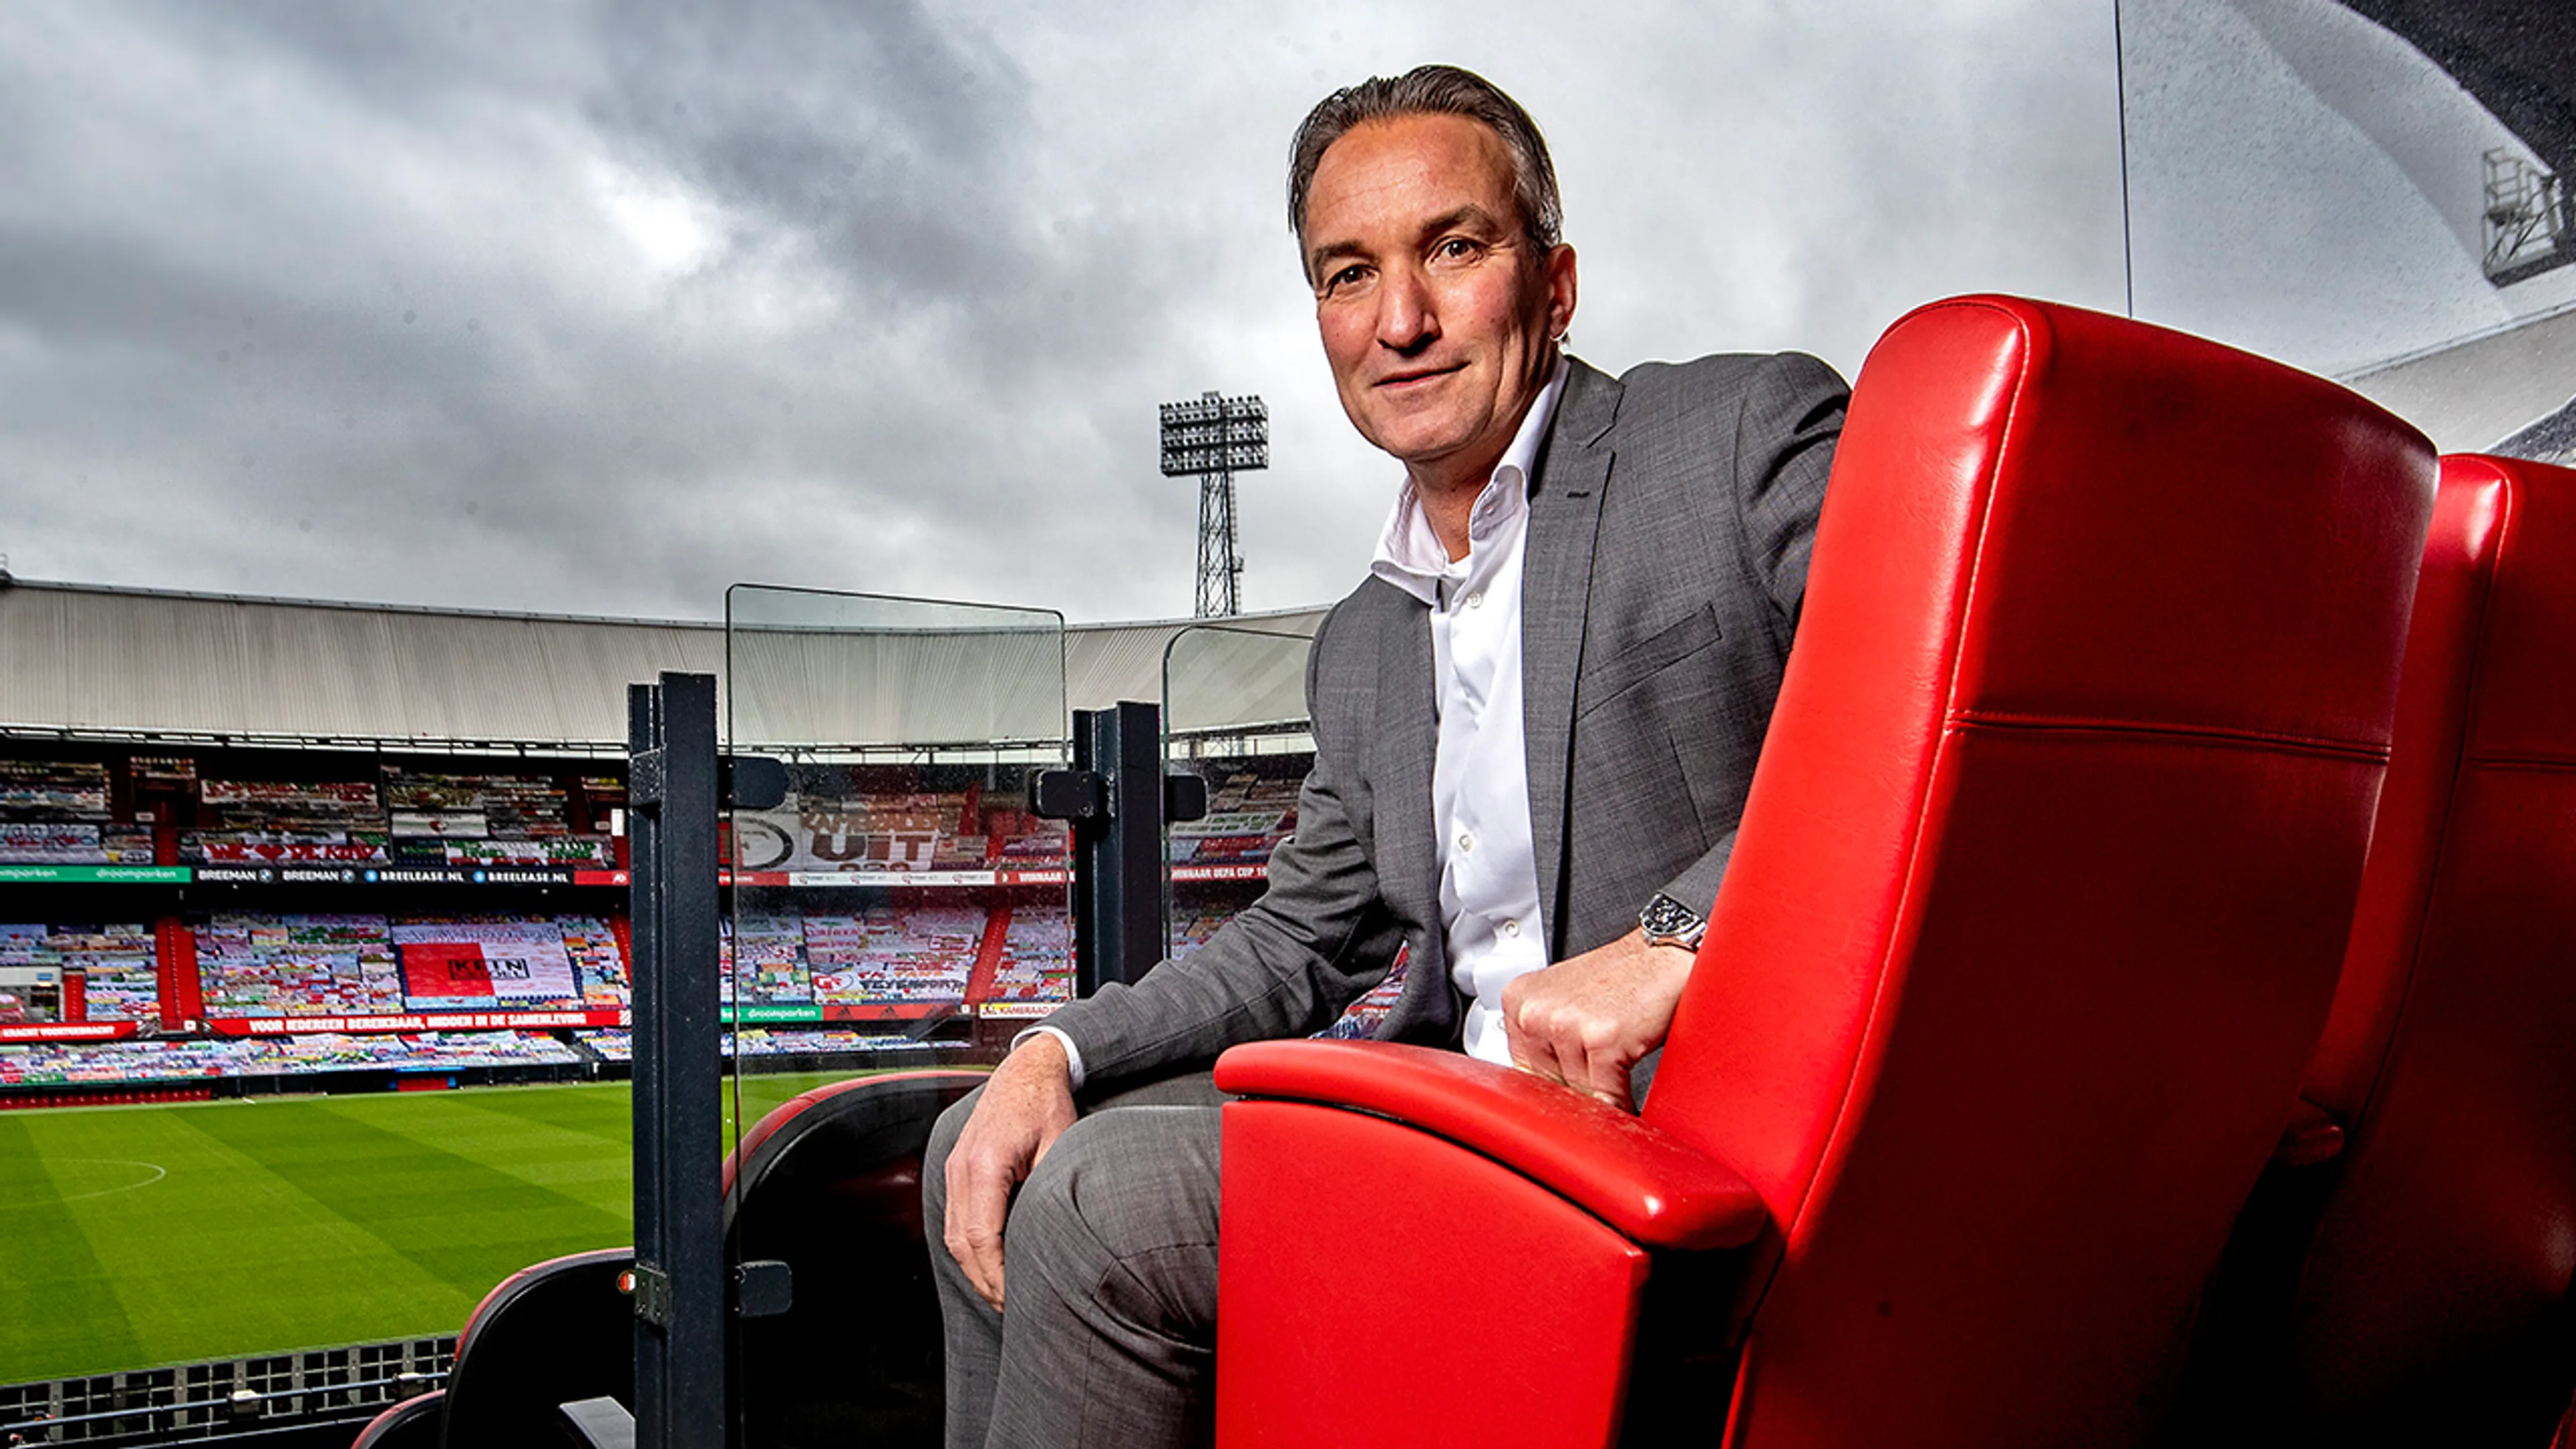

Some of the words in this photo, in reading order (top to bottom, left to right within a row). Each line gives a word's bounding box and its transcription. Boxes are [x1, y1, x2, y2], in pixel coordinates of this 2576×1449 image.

[199, 870, 256, 881] BREEMAN
[282, 871, 339, 881] BREEMAN
[380, 871, 464, 882] BREELEASE.NL
[488, 872, 569, 883] BREELEASE.NL
[1238, 867, 1254, 877] CUP
[748, 1008, 816, 1019] droomparken
[249, 1020, 284, 1032] VOOR
[475, 1014, 488, 1026] IN
[490, 1014, 505, 1025] DE
[507, 1013, 587, 1024] SAMENLEVING
